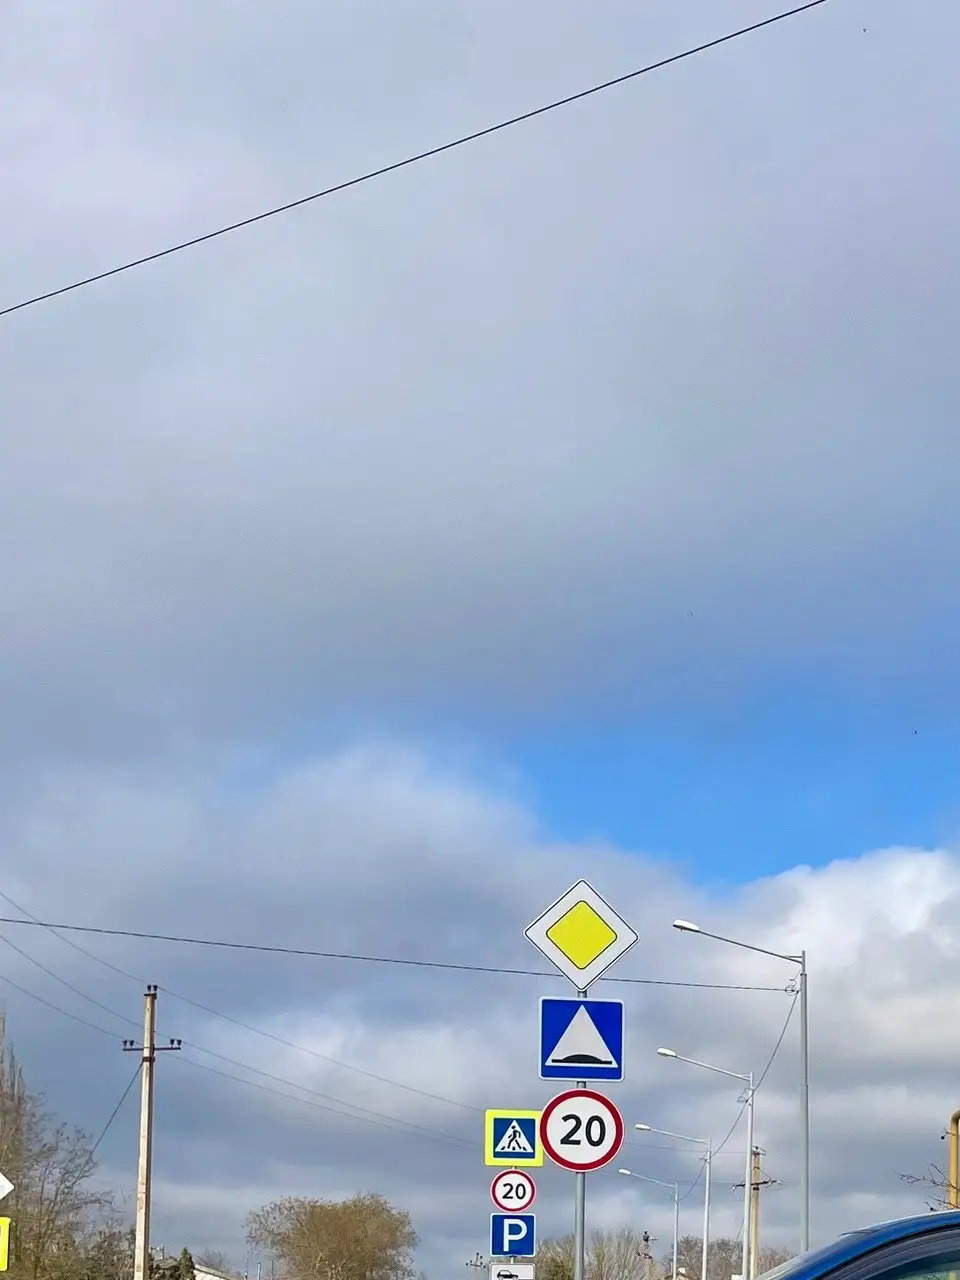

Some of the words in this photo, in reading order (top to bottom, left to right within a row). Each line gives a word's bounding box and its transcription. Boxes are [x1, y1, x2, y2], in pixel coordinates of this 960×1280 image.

[560, 1114, 606, 1147] 20
[502, 1183, 526, 1200] 20
[503, 1219, 527, 1252] P
